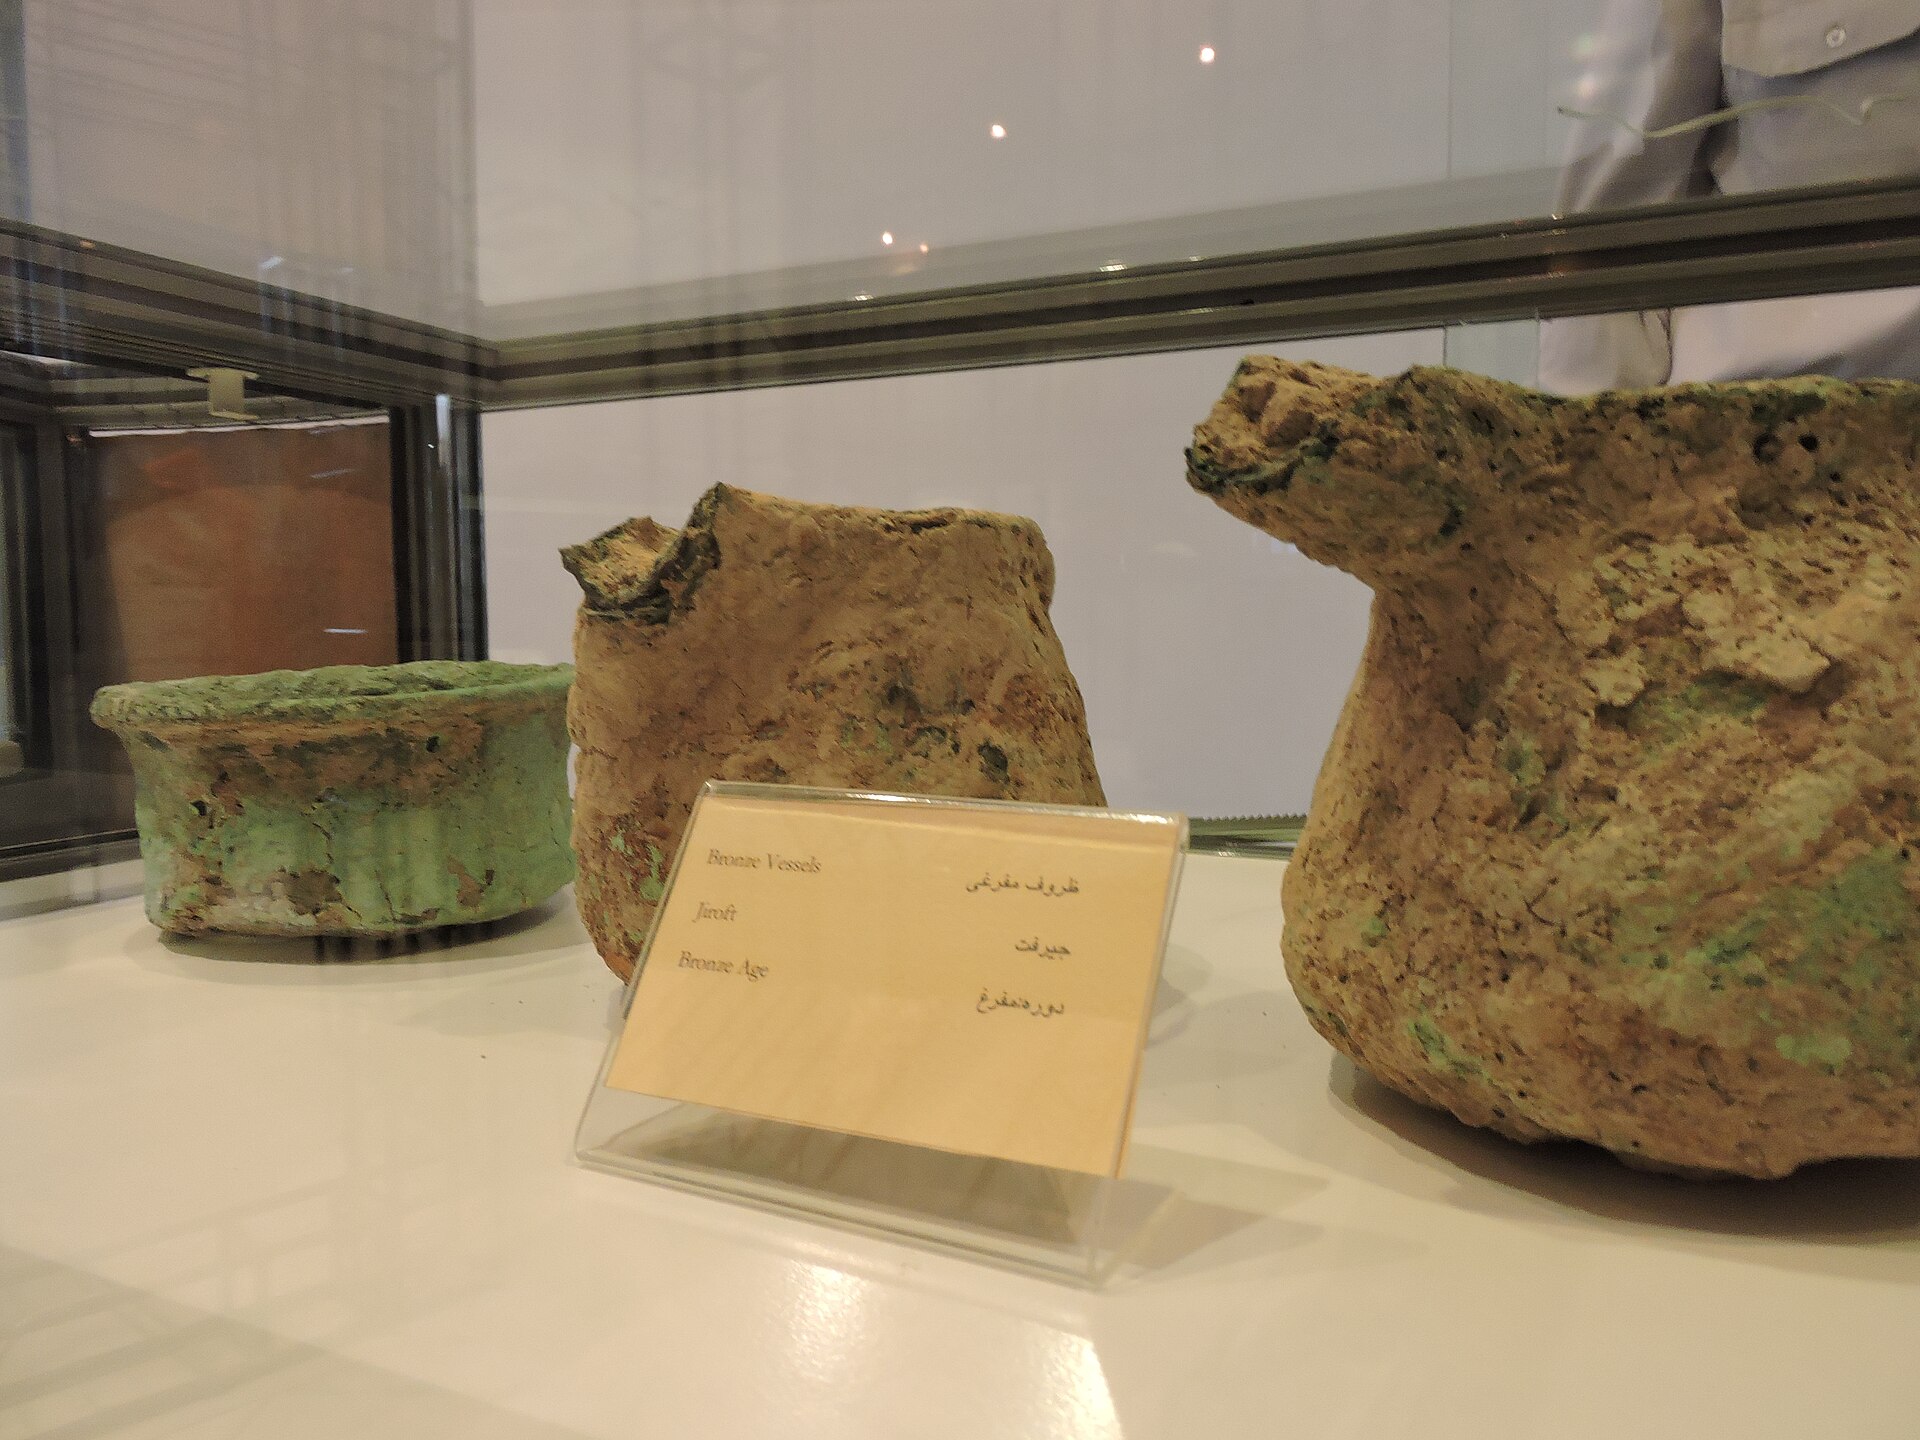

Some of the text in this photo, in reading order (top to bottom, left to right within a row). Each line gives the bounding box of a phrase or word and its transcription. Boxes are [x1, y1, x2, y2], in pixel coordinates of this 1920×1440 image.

[707, 848, 822, 874] Bronze Vessels
[1025, 876, 1080, 897] ظروف
[692, 901, 738, 923] Jiroft
[1014, 935, 1072, 961] جیرفت
[678, 950, 770, 983] Bronze Age
